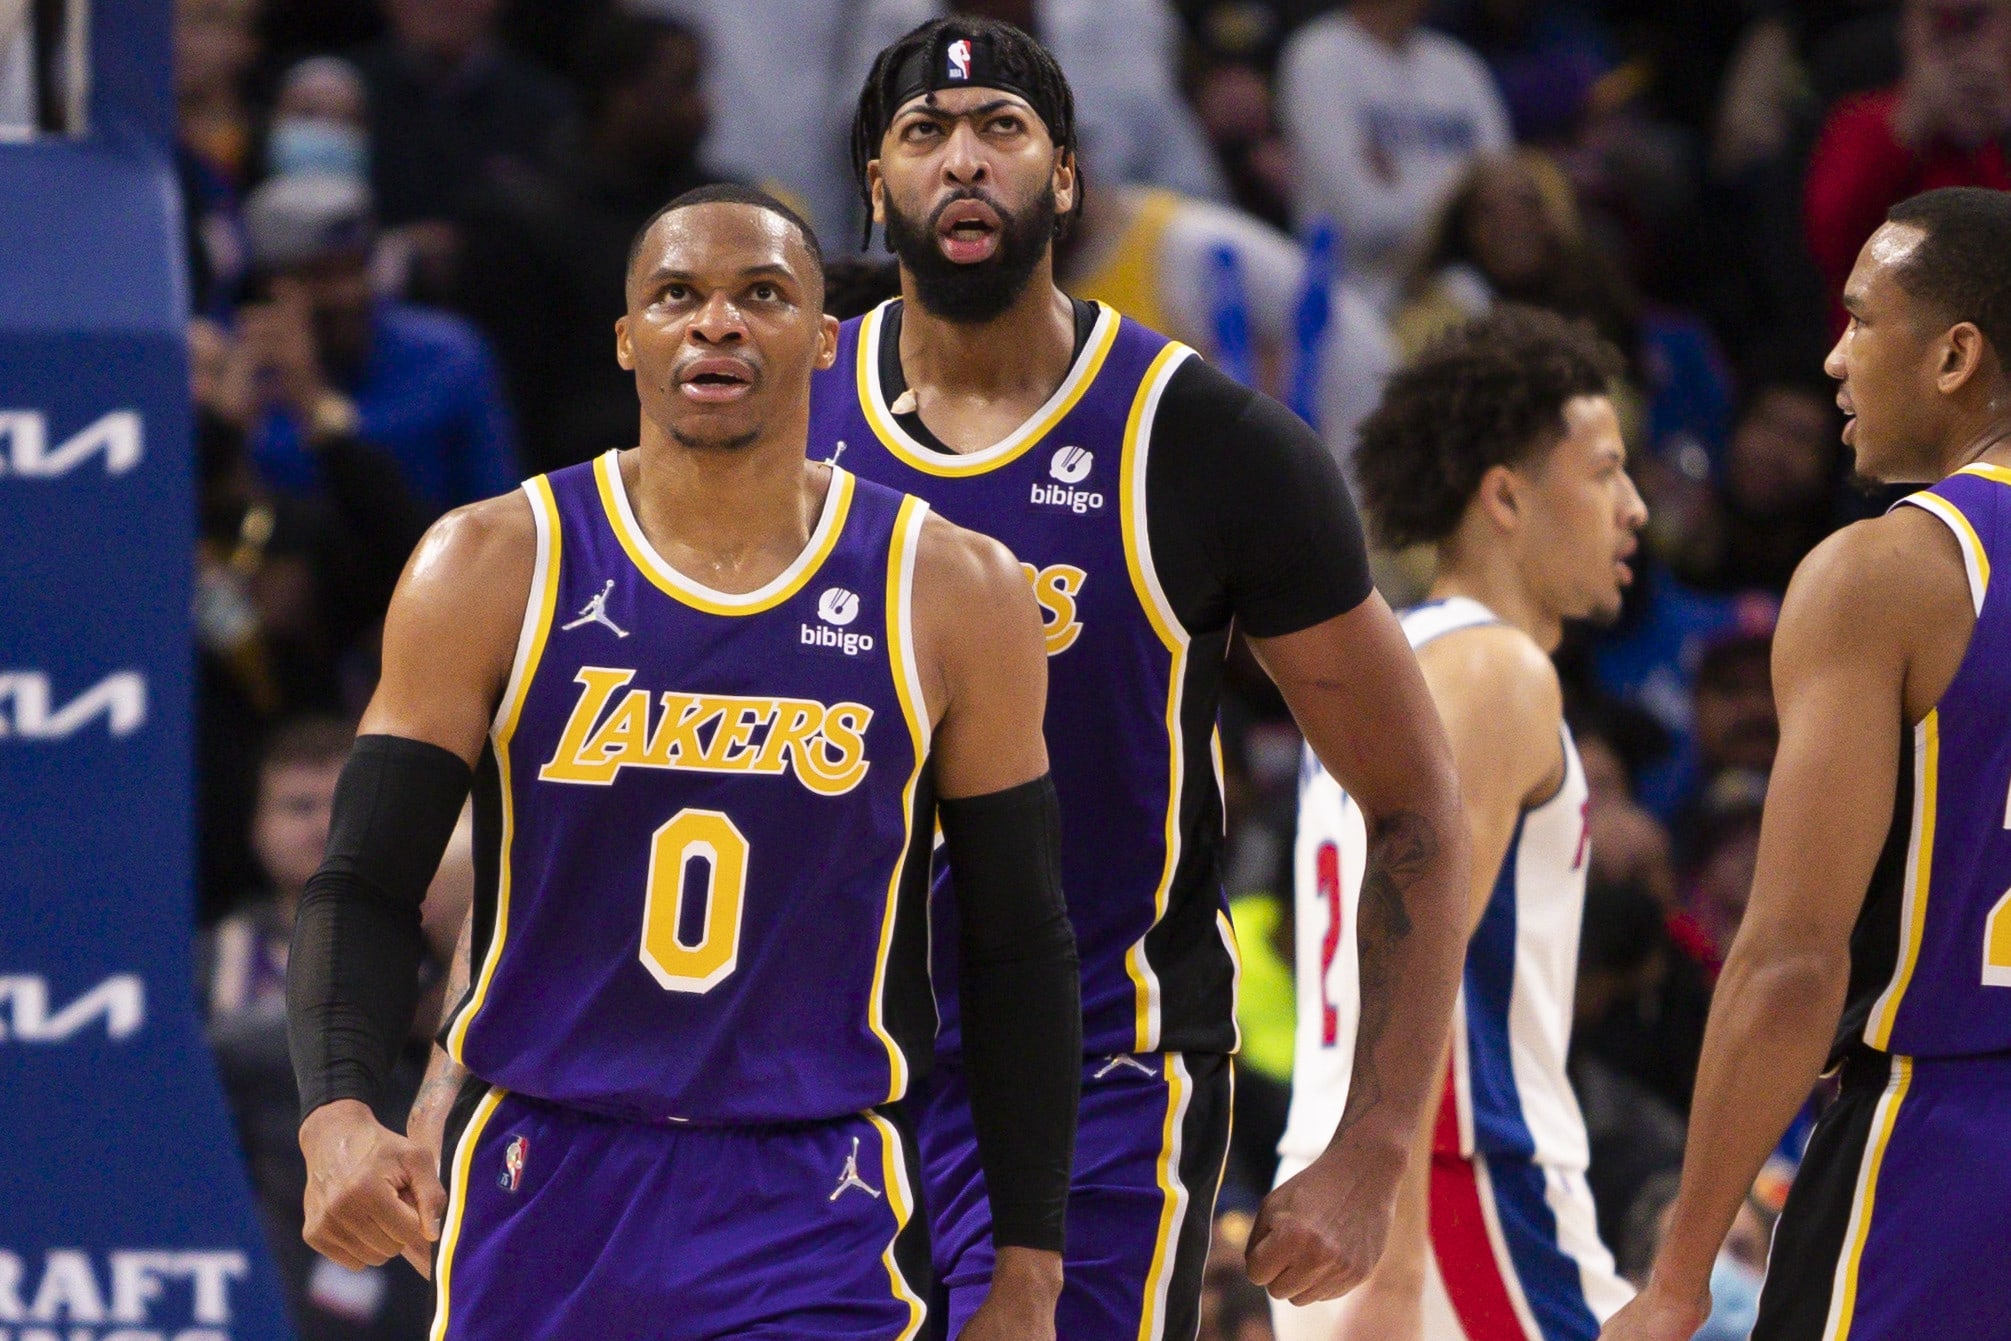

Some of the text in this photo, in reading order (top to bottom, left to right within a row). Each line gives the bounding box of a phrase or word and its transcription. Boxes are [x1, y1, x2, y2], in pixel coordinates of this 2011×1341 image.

[1030, 483, 1103, 513] bibigo
[801, 623, 873, 655] bibigo
[538, 666, 875, 796] LAKERS
[639, 808, 749, 994] 0
[1315, 840, 1341, 1048] 2
